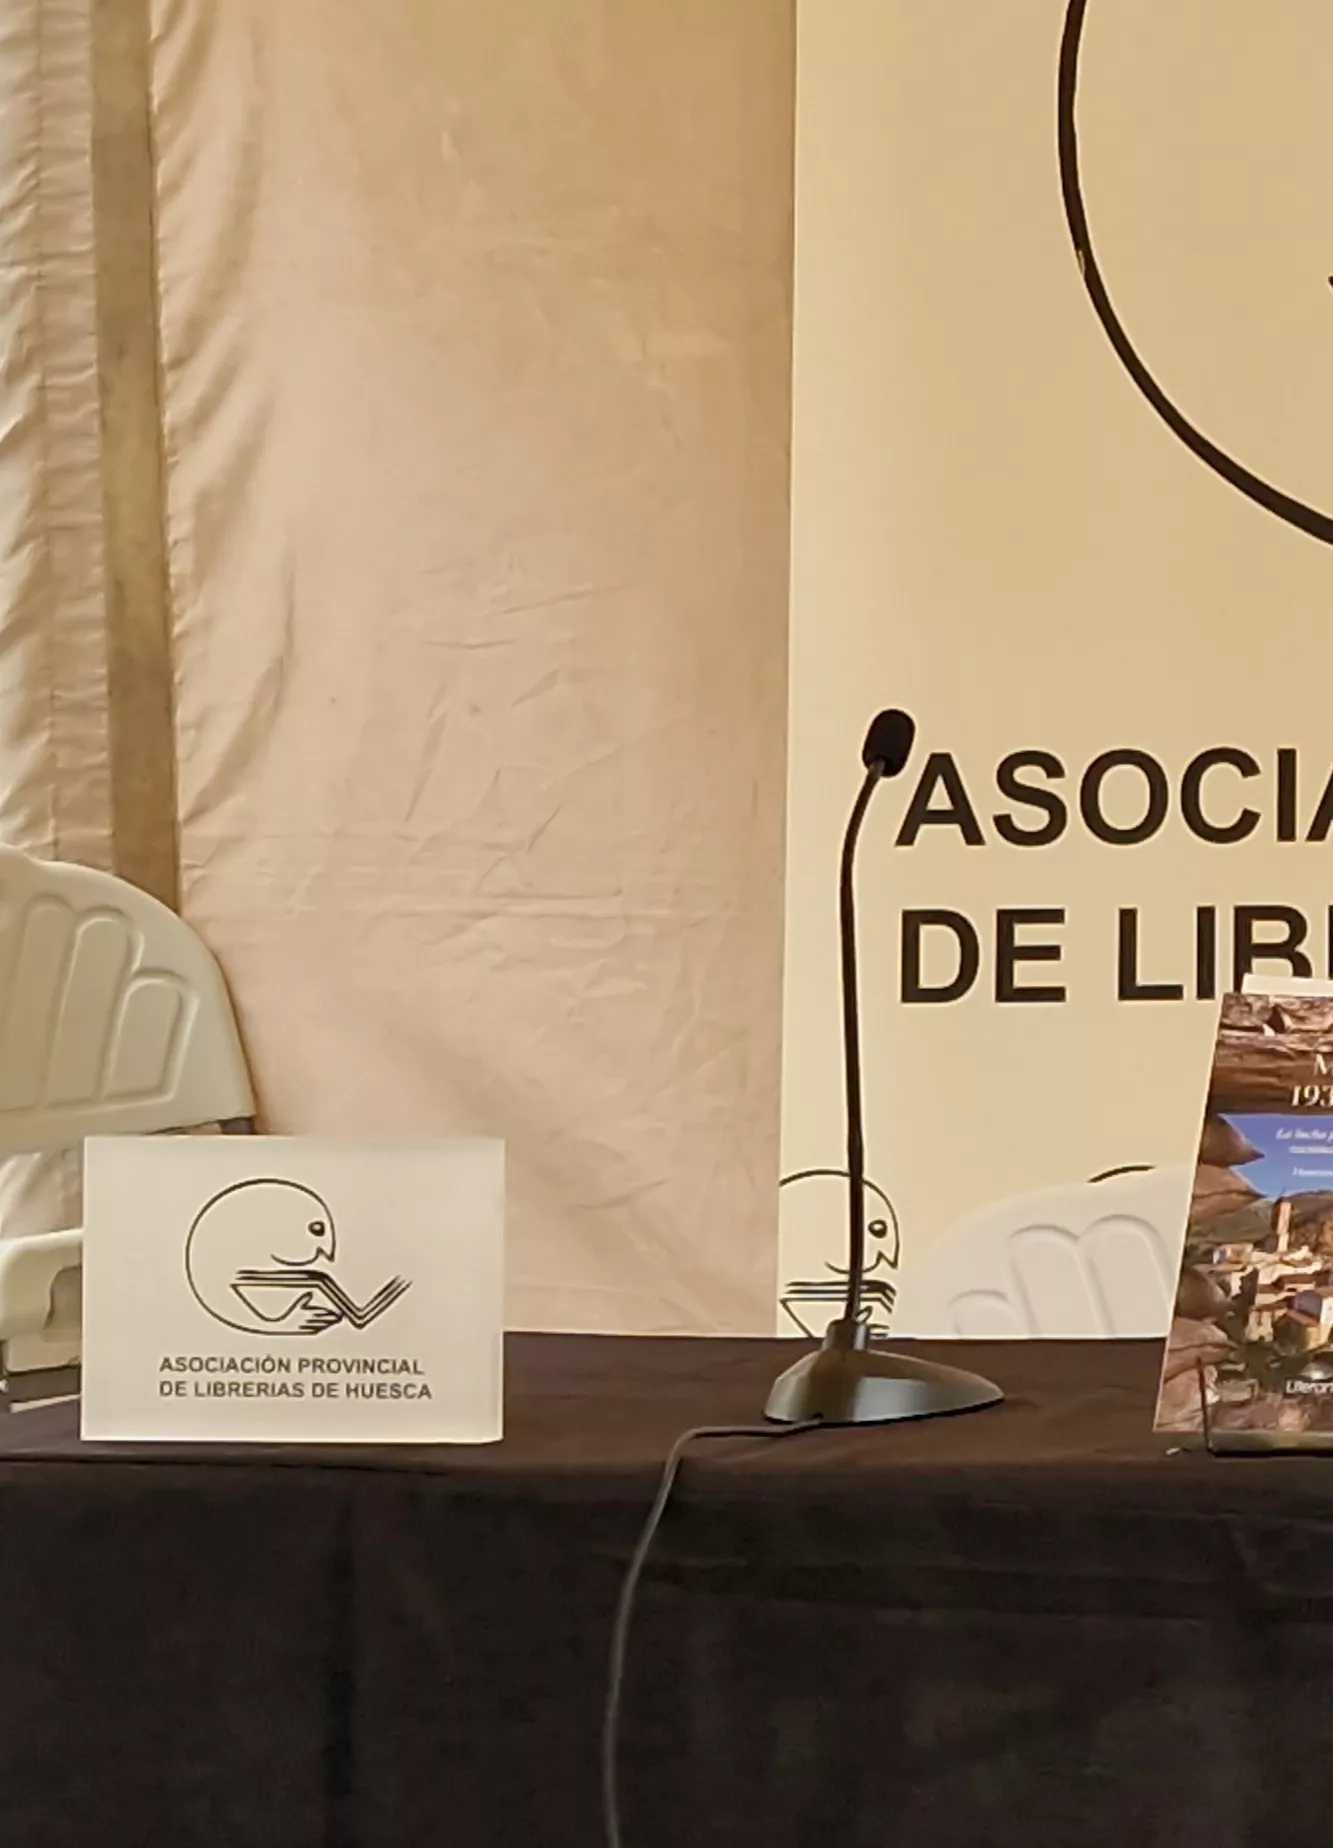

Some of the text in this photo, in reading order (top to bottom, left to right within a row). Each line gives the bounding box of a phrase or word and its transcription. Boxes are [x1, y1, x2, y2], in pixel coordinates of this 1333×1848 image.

[899, 908, 1067, 1003] DE
[159, 1354, 426, 1376] ASOCIACIÓN PROVINCIAL
[159, 1380, 433, 1400] DE LIBRERIAS DE HUESCA
